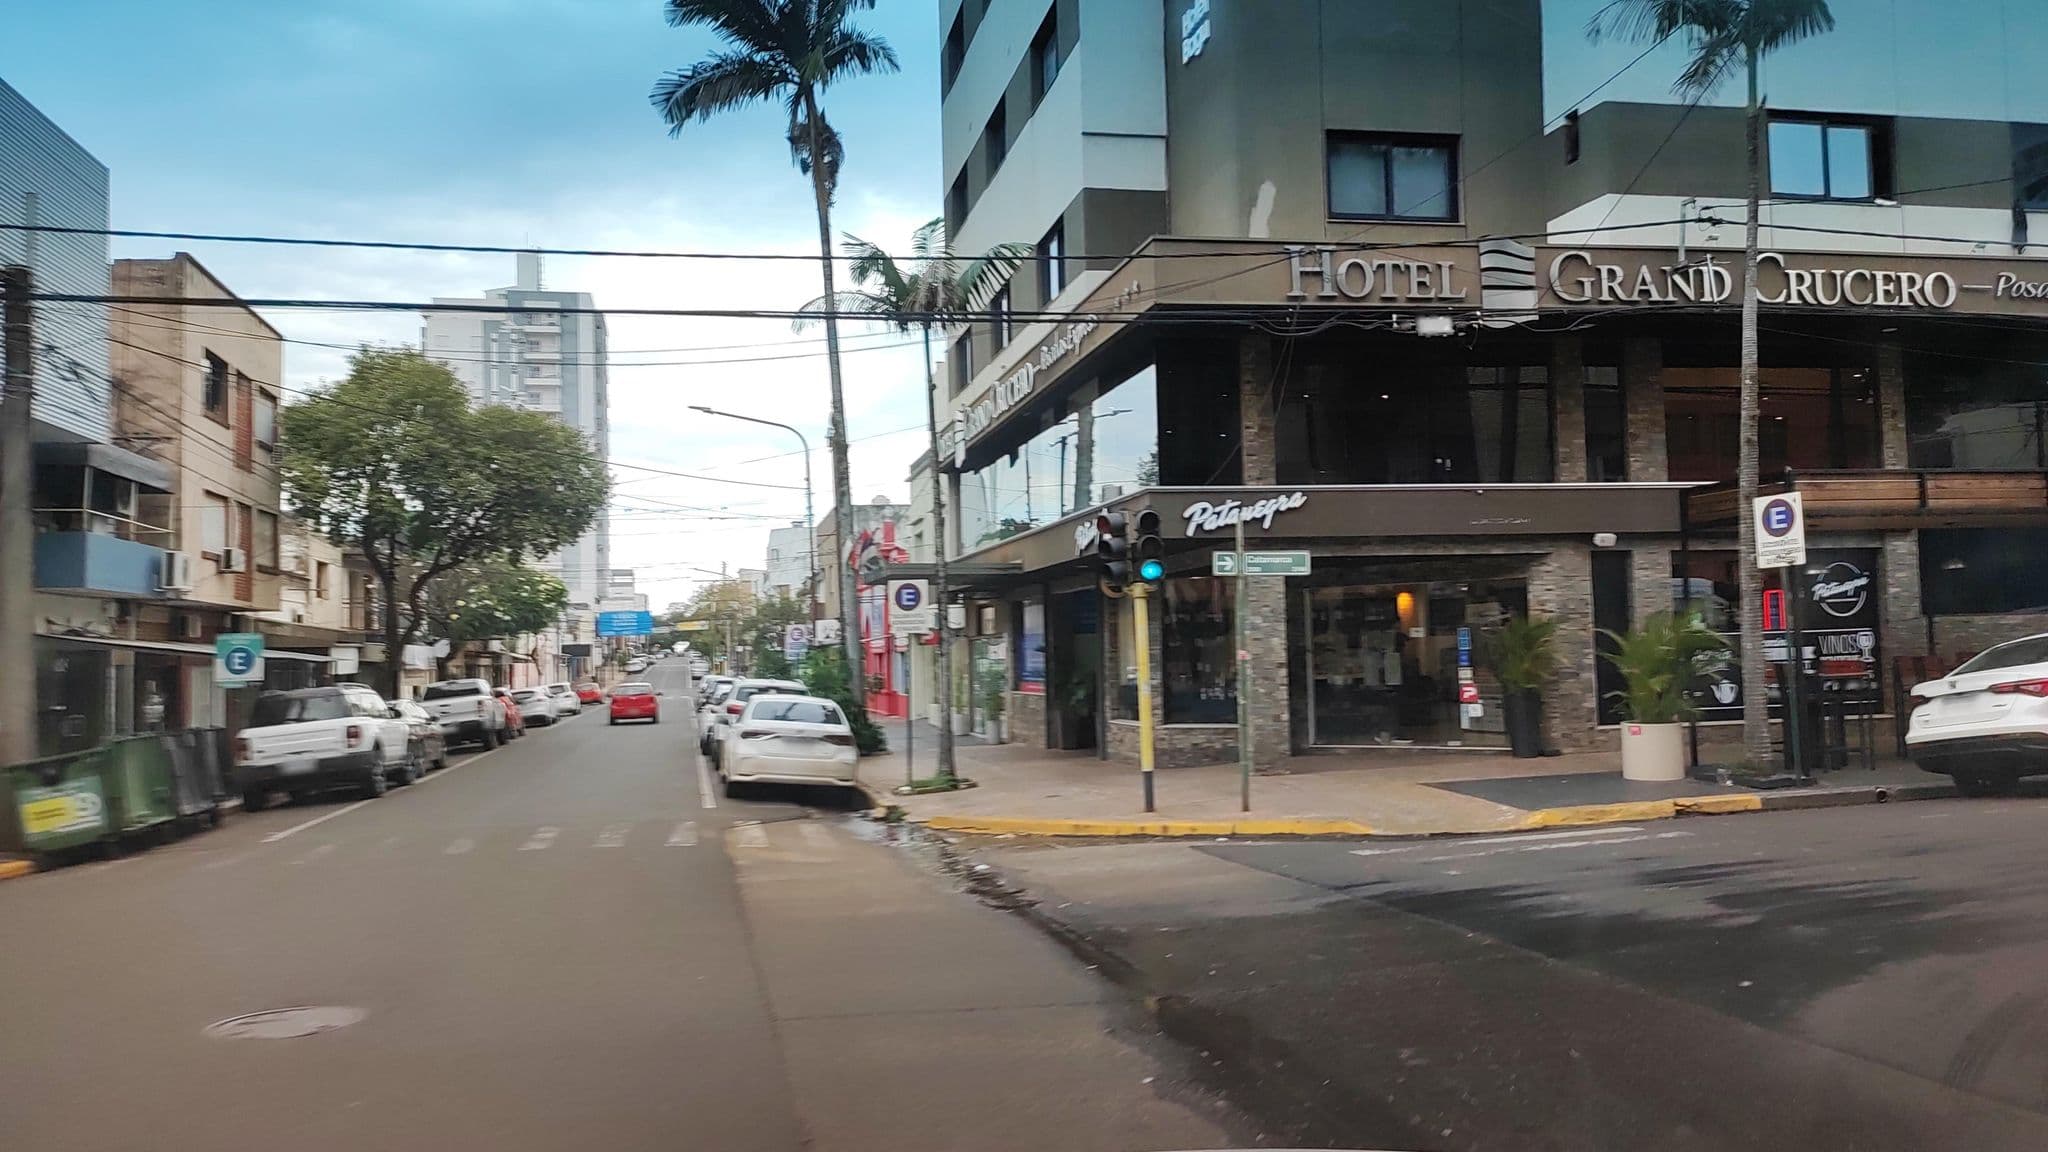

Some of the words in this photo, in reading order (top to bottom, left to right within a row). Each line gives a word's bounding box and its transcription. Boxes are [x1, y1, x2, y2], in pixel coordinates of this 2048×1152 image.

[1284, 245, 1467, 299] HOTEL
[1549, 251, 1733, 302] GRAND
[1756, 252, 1957, 309] CRUCERO
[1182, 492, 1308, 537] Patanegra
[1769, 506, 1788, 530] E
[901, 588, 916, 606] E
[230, 652, 248, 670] E
